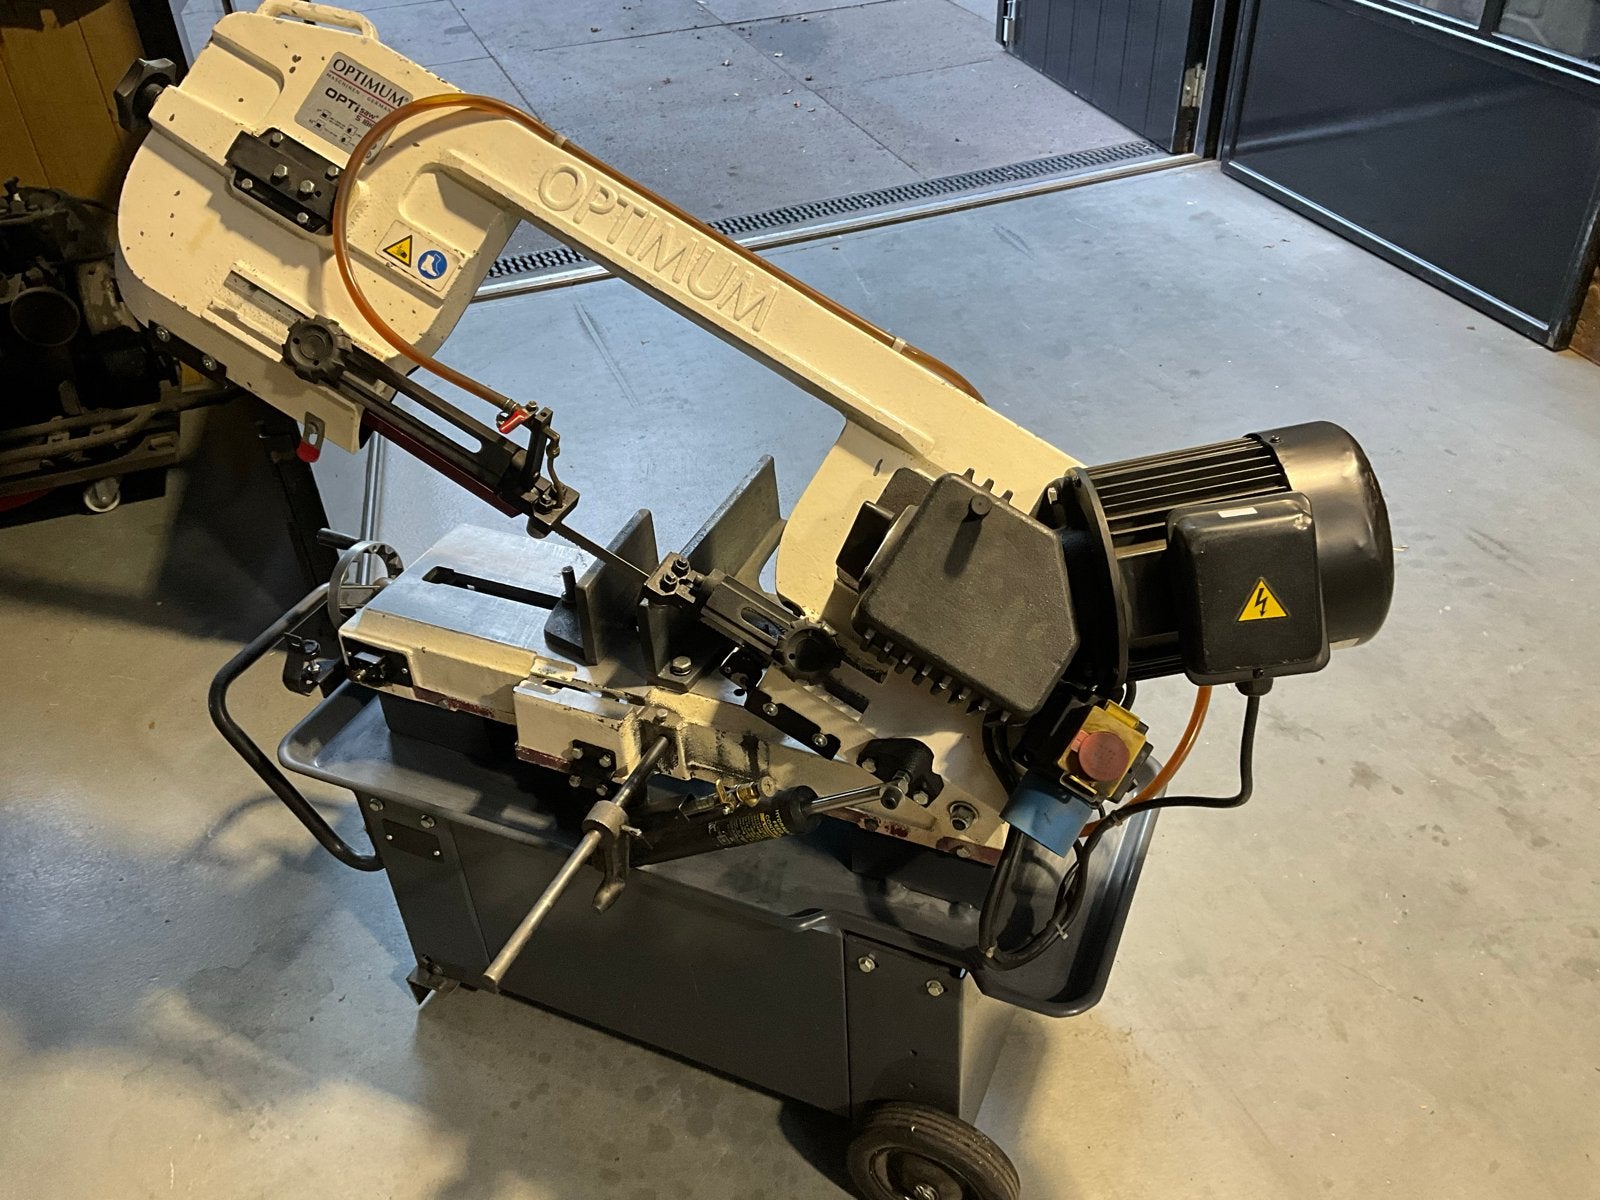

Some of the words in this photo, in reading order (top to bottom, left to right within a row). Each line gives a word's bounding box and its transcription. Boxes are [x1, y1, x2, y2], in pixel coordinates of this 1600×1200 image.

[326, 72, 360, 95] MASCHINEN
[366, 96, 391, 112] GERMAN
[333, 58, 405, 107] OPTIMUM
[538, 162, 779, 332] OPTIMUM
